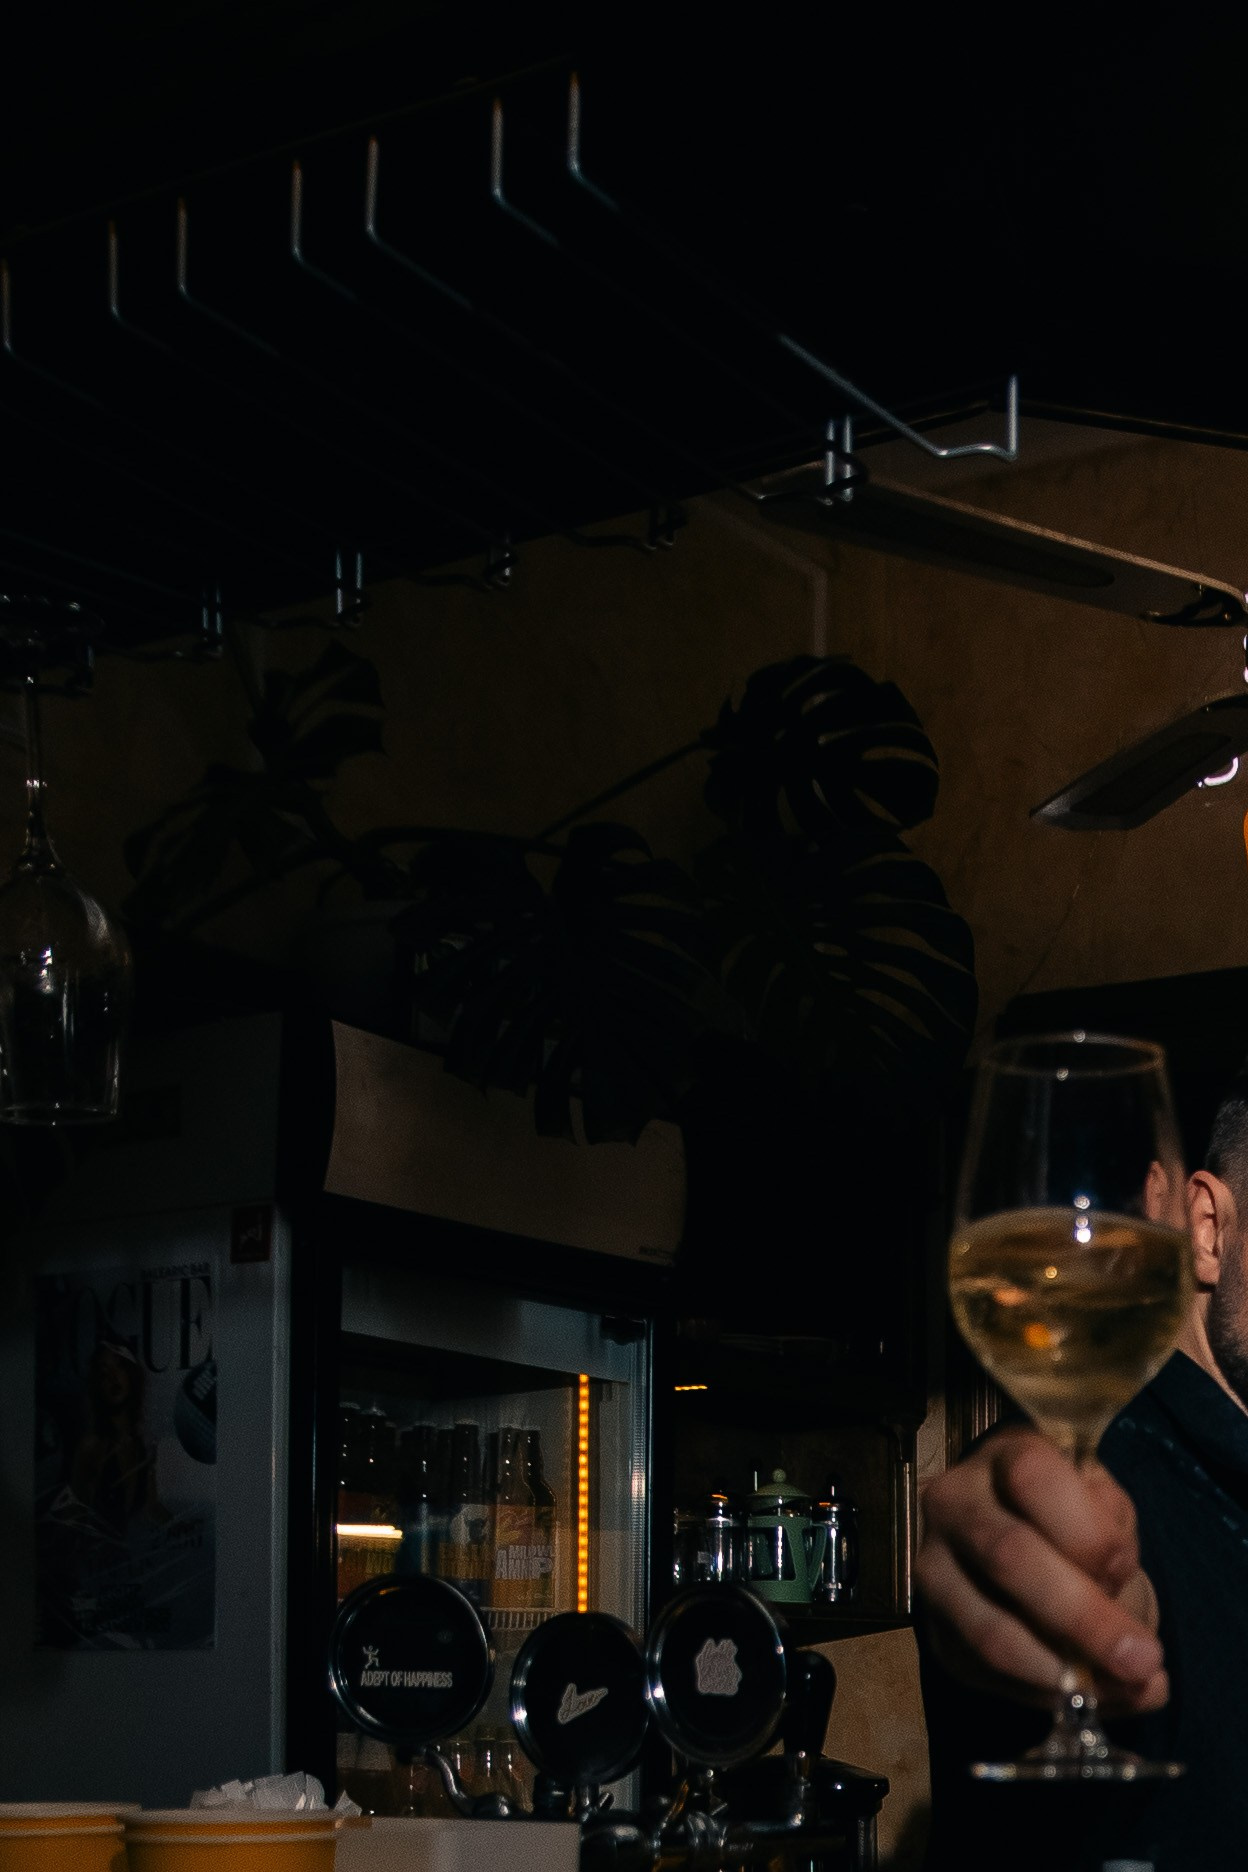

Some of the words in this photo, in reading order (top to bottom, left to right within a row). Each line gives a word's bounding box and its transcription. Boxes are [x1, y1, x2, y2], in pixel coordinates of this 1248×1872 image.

[190, 1262, 211, 1276] BAR
[360, 1669, 391, 1687] ADEPT
[391, 1670, 403, 1688] OF
[404, 1670, 453, 1689] HAPPINESS
